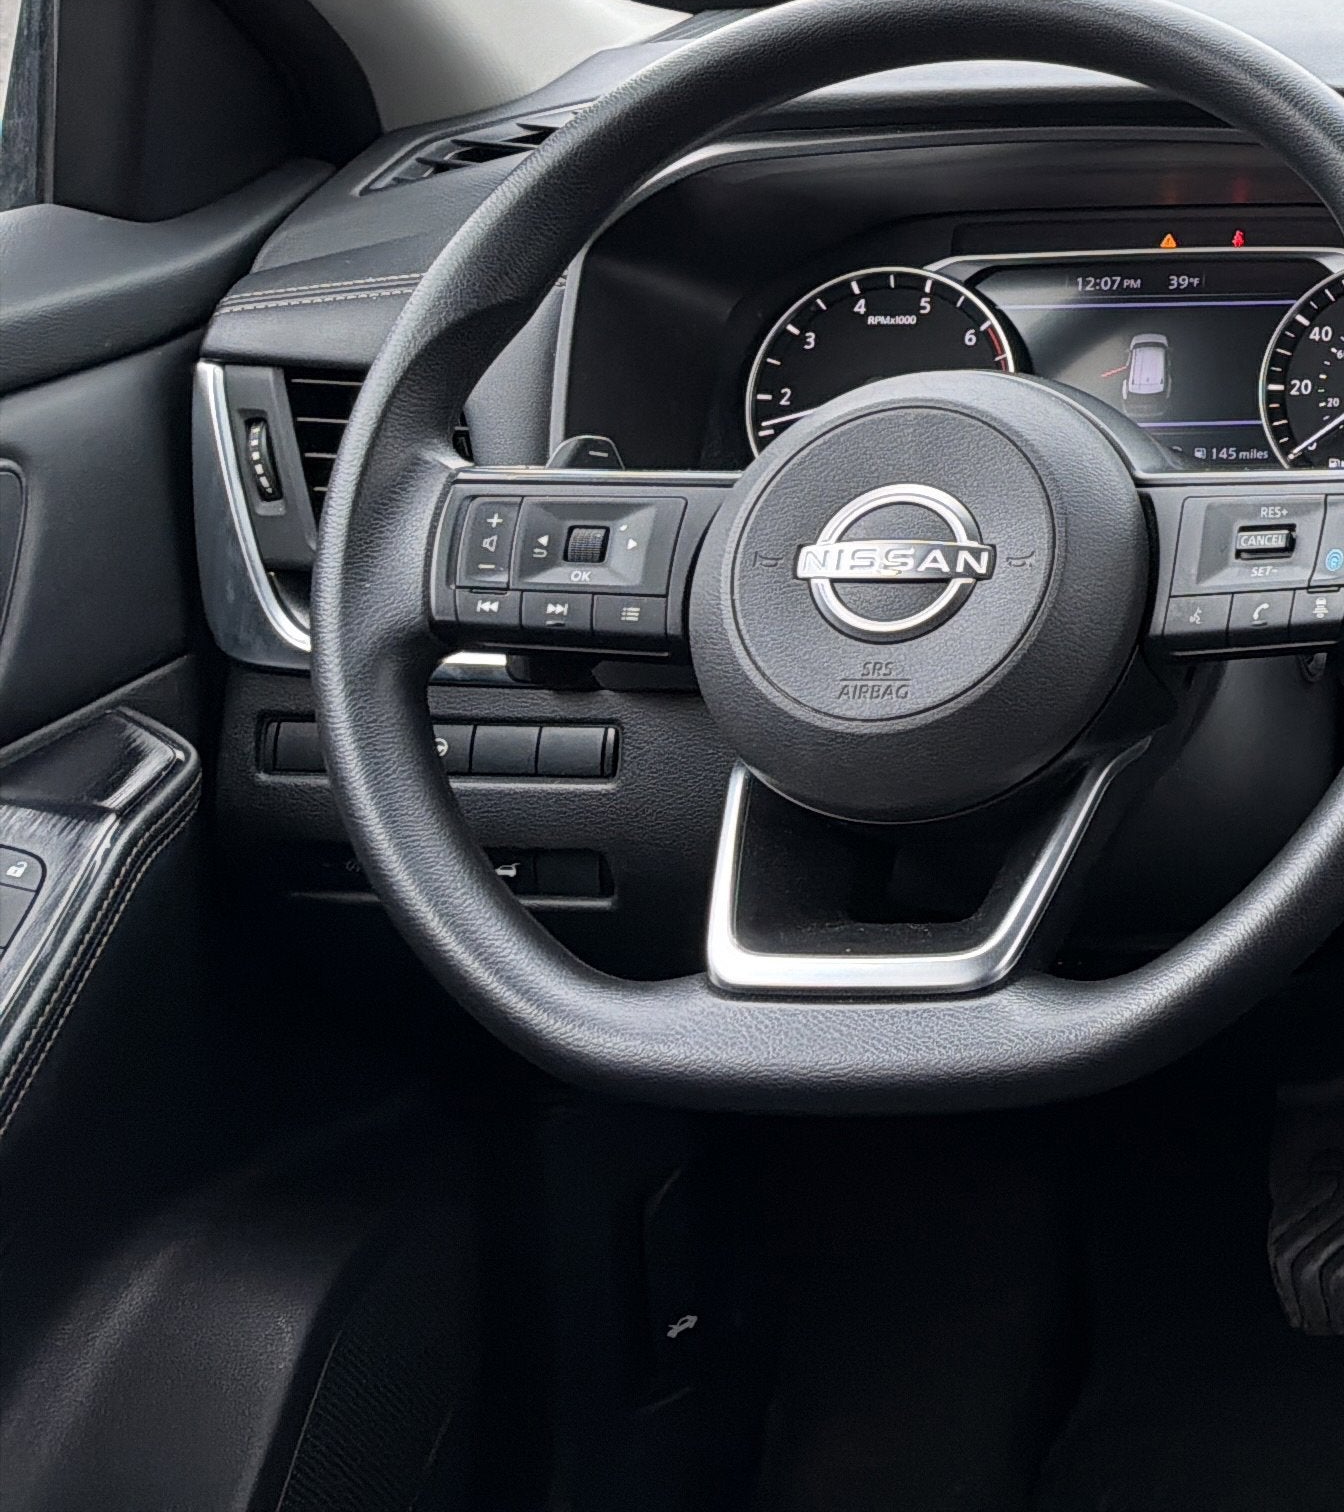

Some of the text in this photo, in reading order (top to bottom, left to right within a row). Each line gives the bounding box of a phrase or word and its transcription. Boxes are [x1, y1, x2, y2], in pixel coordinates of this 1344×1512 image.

[1077, 276, 1142, 291] 12:07 PM
[853, 299, 866, 314] 4
[919, 297, 931, 314] 5
[804, 333, 816, 349] 3
[964, 330, 977, 346] 6
[1309, 326, 1333, 342] 40
[1290, 380, 1312, 395] 20
[779, 389, 791, 406] 2
[1326, 398, 1340, 408] 20
[1211, 448, 1269, 459] 145 miles
[1240, 534, 1286, 547] CANCEL
[803, 548, 989, 574] NISSAN
[570, 570, 593, 582] OK
[861, 662, 894, 677] SRS
[837, 684, 909, 700] AIRBAG
